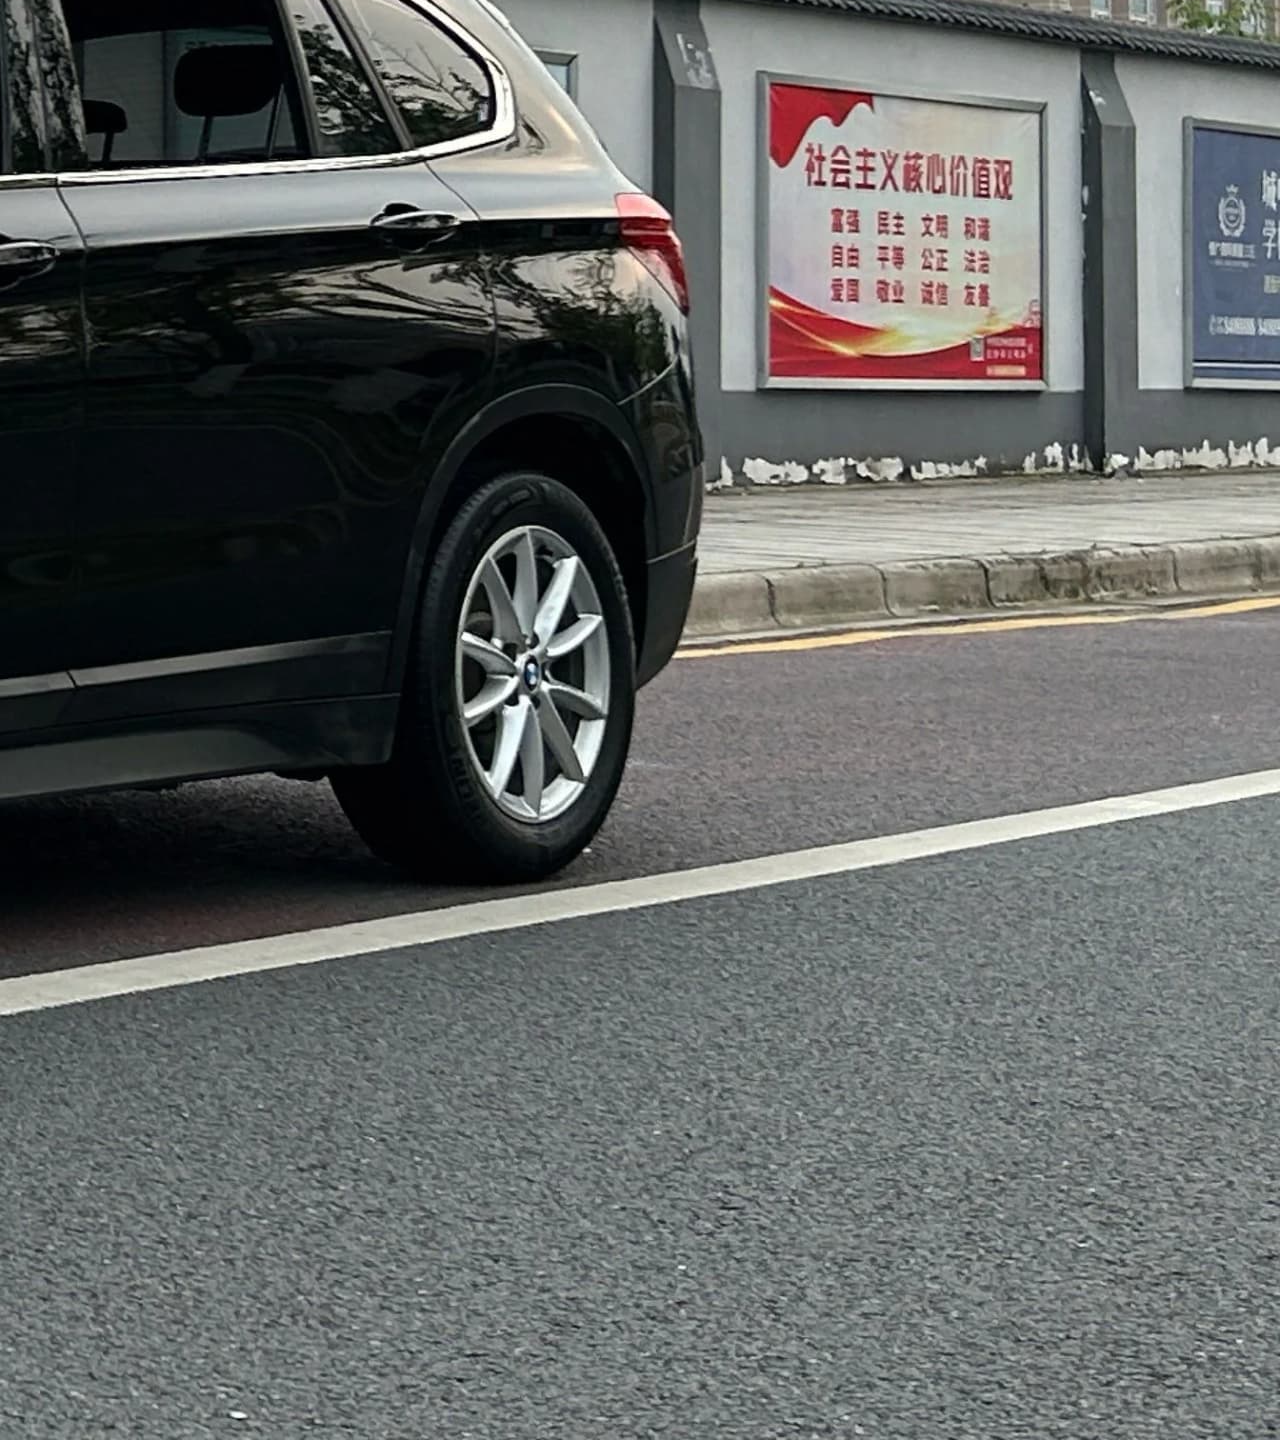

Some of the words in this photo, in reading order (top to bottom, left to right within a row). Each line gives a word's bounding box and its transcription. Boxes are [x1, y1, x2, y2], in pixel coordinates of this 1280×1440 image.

[804, 142, 1013, 201] 社会主义核心价值观
[831, 207, 860, 234] 富强
[877, 211, 906, 236] 民主
[920, 213, 949, 239] 文明
[963, 216, 991, 241] 和谐
[831, 242, 860, 269] 自由
[876, 245, 905, 271] 平等
[920, 247, 949, 272] 公正
[963, 248, 990, 274] 法治
[831, 277, 860, 303] 爱国
[876, 279, 905, 304] 敬业
[920, 280, 949, 306] 诚信
[963, 282, 990, 307] 友善
